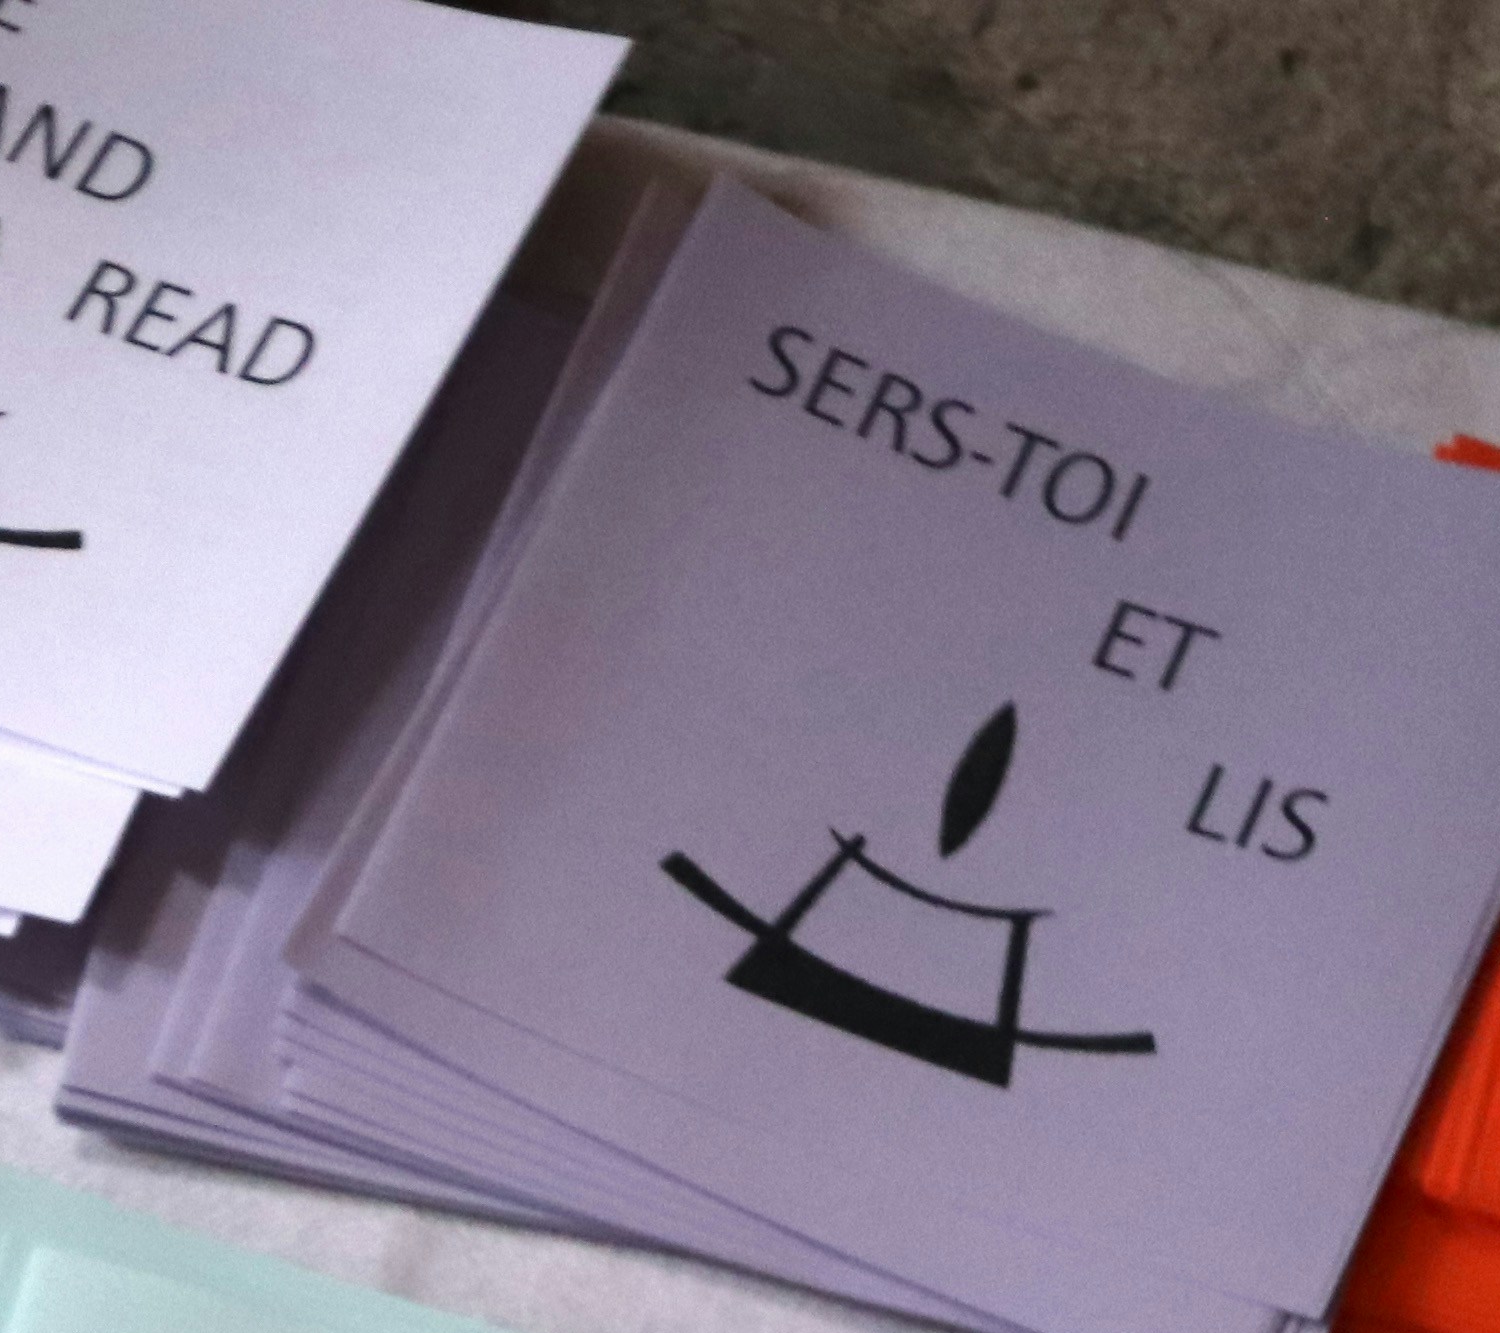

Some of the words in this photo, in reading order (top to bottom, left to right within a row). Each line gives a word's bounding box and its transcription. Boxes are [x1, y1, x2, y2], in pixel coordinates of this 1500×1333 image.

[65, 259, 315, 386] READ
[744, 322, 1149, 541] SERS-TOI
[1092, 600, 1220, 691] ET
[1186, 764, 1327, 861] LIS
